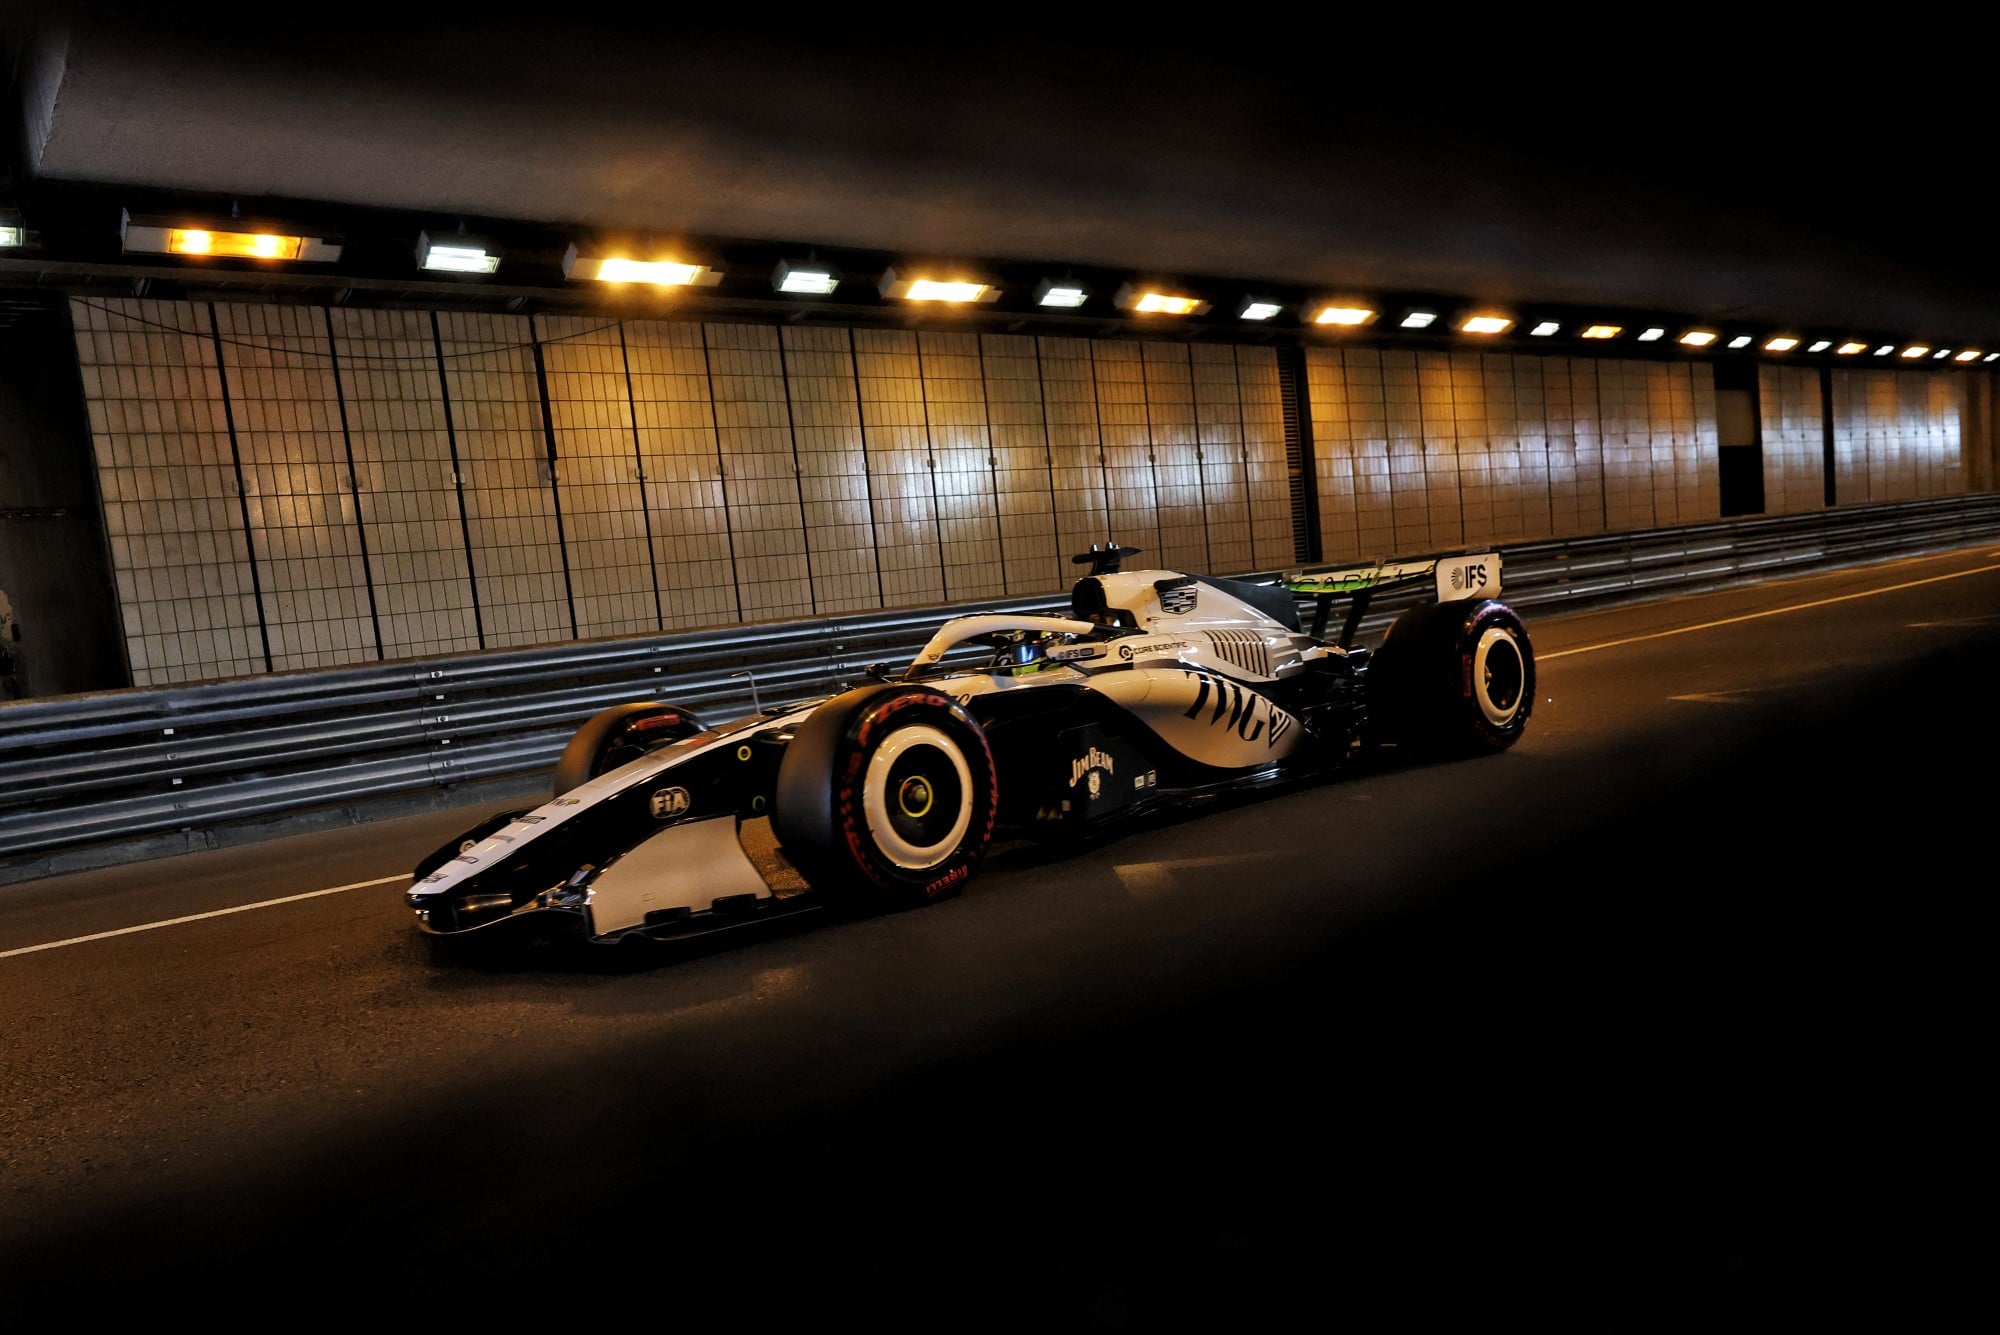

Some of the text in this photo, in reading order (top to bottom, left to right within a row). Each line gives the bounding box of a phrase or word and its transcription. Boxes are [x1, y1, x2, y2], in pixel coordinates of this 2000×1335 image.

[1465, 564, 1487, 589] IFS
[1133, 645, 1153, 655] CORE
[1069, 747, 1114, 788] JIM BEAM
[652, 792, 688, 815] FIA
[926, 865, 968, 894] PIRELLI
